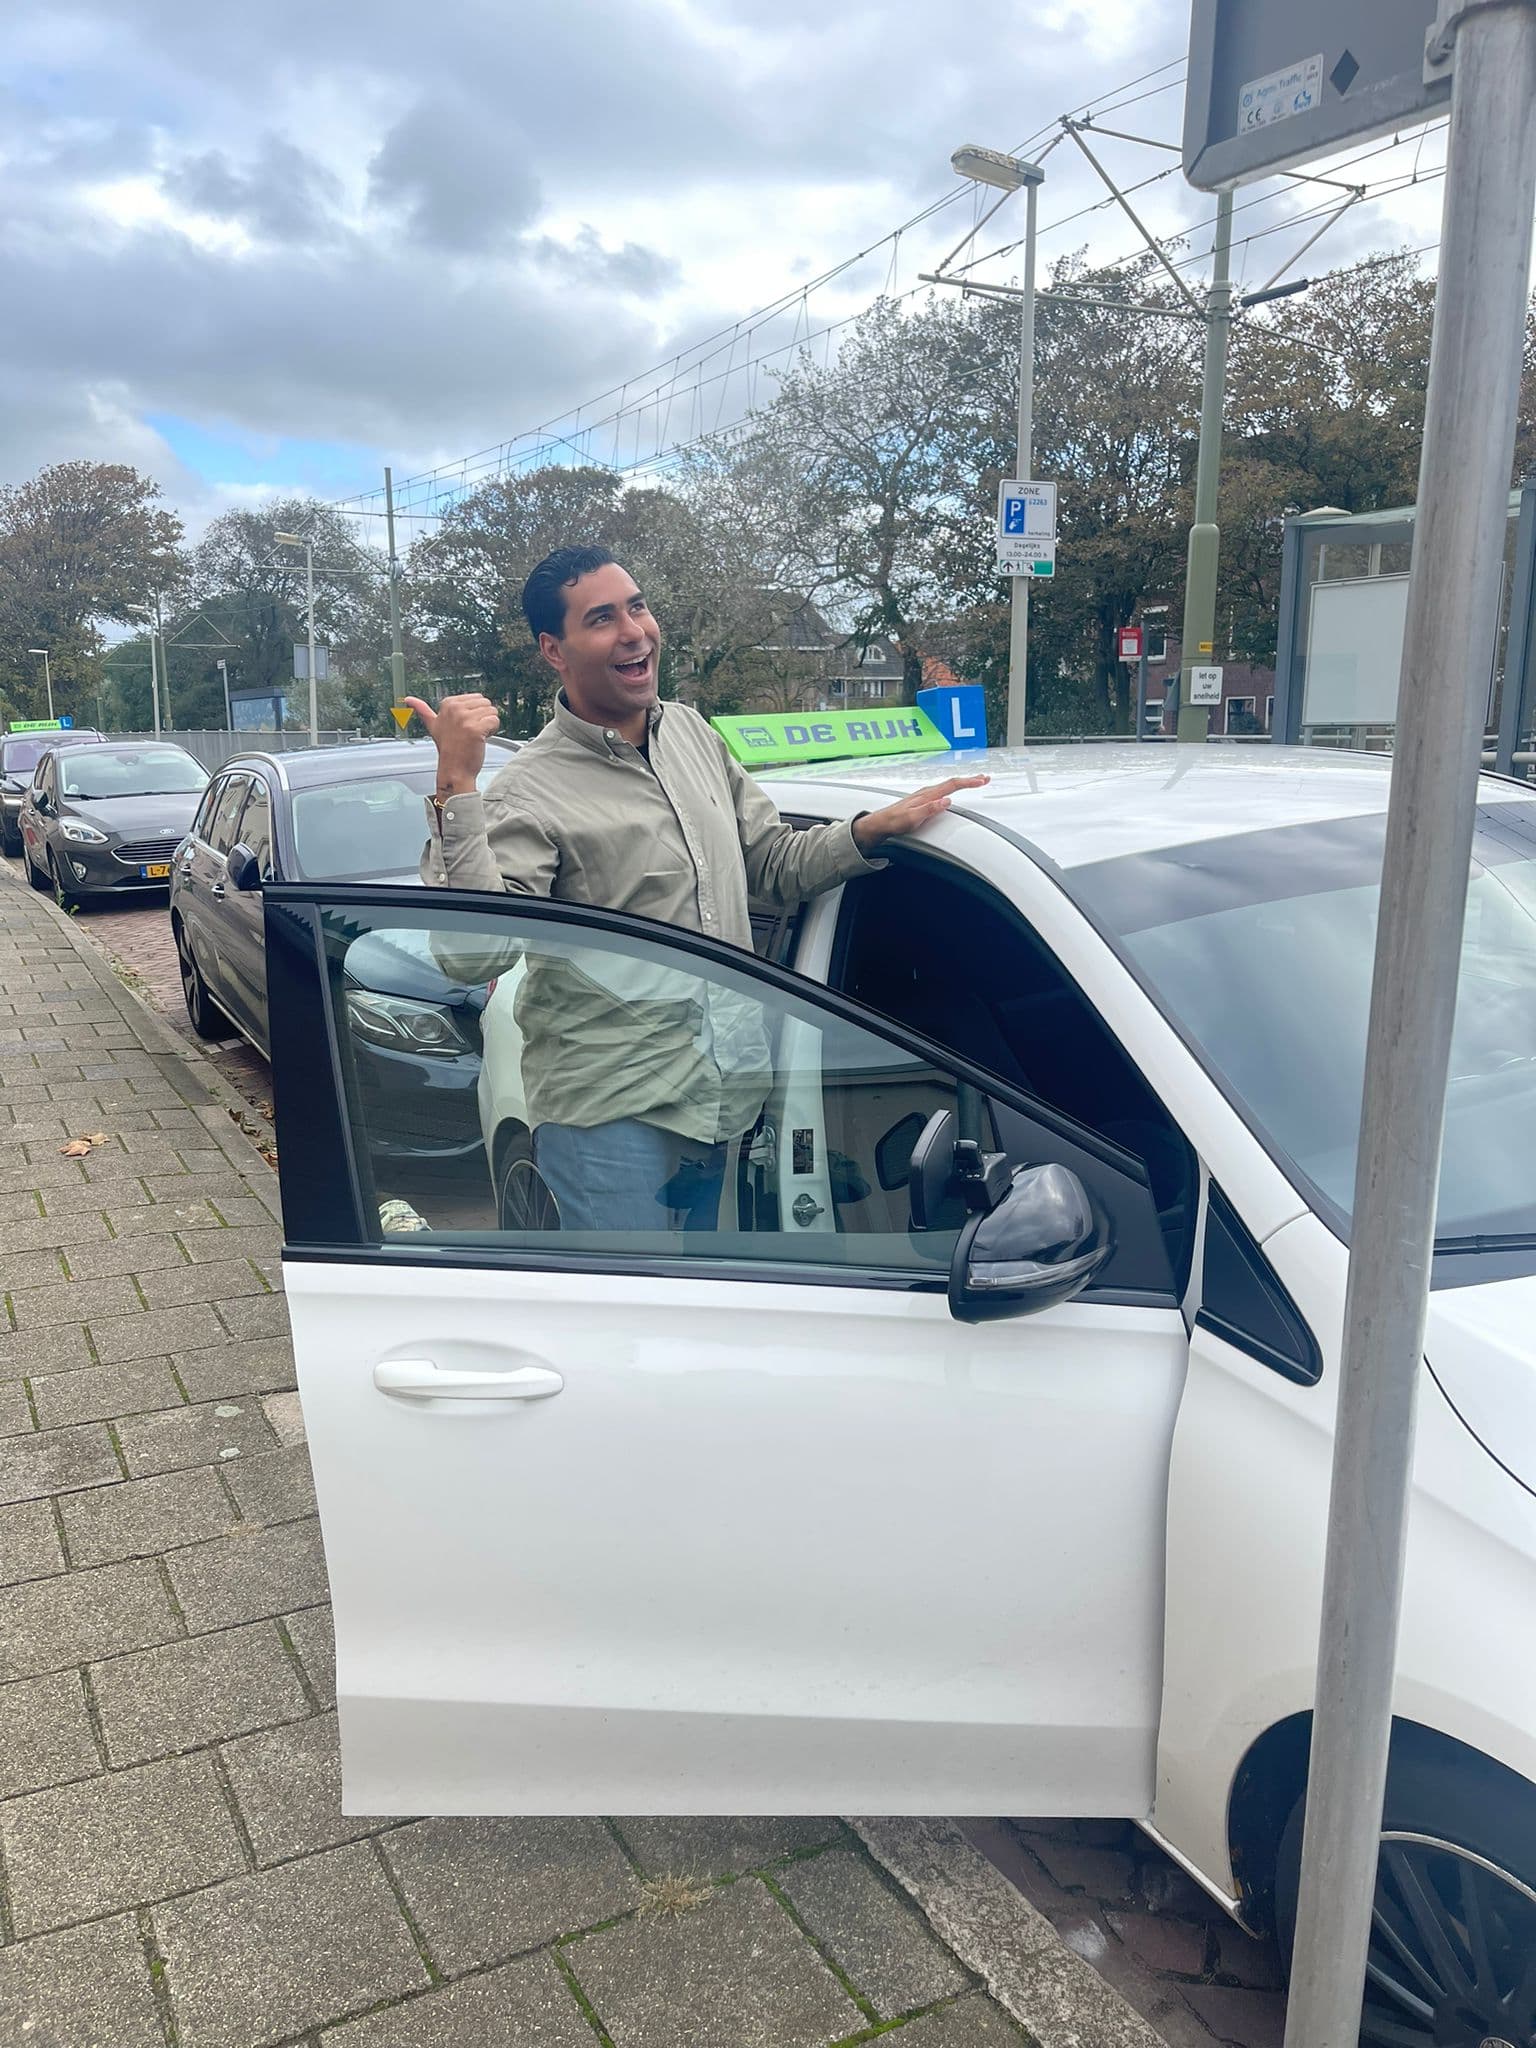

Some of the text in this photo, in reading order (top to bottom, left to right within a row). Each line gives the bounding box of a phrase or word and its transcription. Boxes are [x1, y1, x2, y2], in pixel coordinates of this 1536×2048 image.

[1018, 487, 1040, 495] ZONE
[1208, 673, 1217, 681] op
[1193, 692, 1220, 700] snelheid
[951, 697, 975, 738] L
[63, 718, 71, 727] L
[783, 718, 923, 746] DE RIJK
